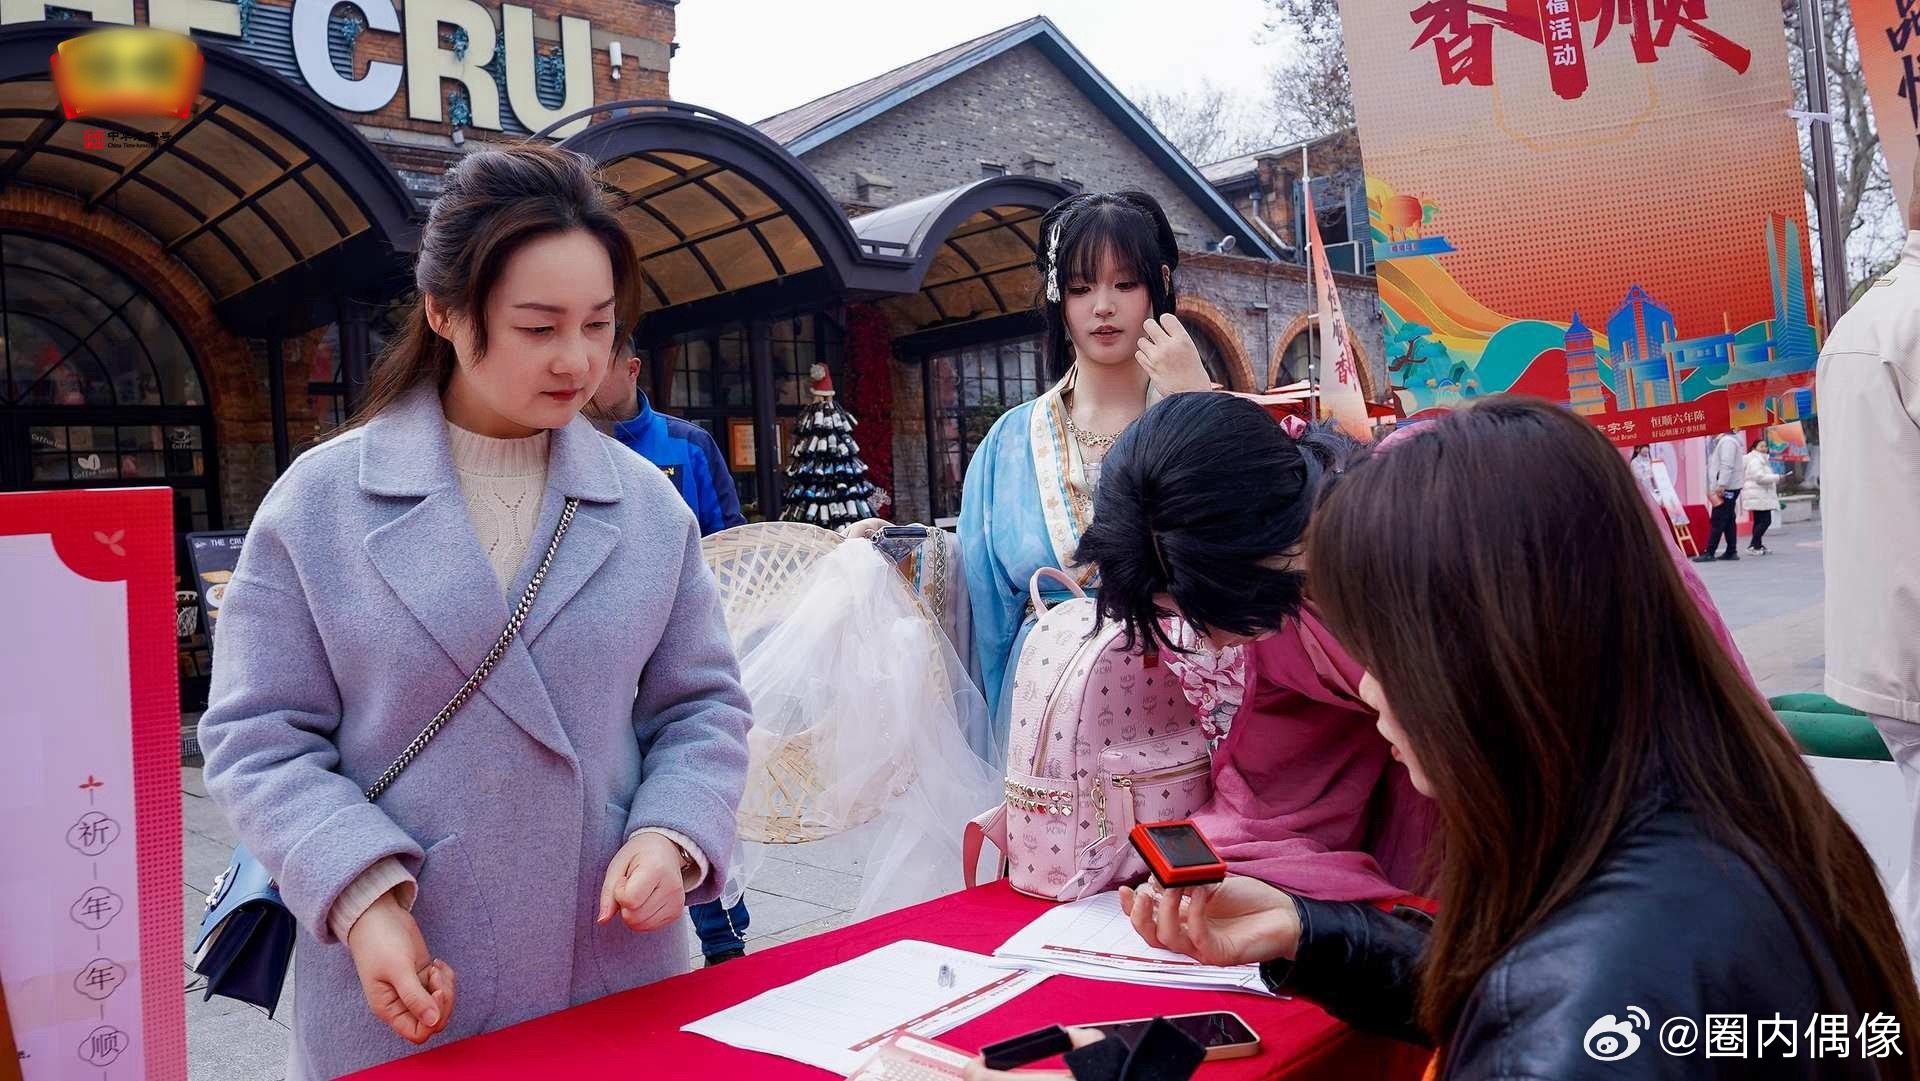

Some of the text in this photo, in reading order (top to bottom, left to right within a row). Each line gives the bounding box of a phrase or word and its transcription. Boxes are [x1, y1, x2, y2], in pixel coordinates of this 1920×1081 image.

[1546, 0, 1579, 67] 福活动
[292, 0, 594, 139] CRU
[1651, 411, 1705, 427] 恒顺六年陈
[210, 539, 225, 547] THE
